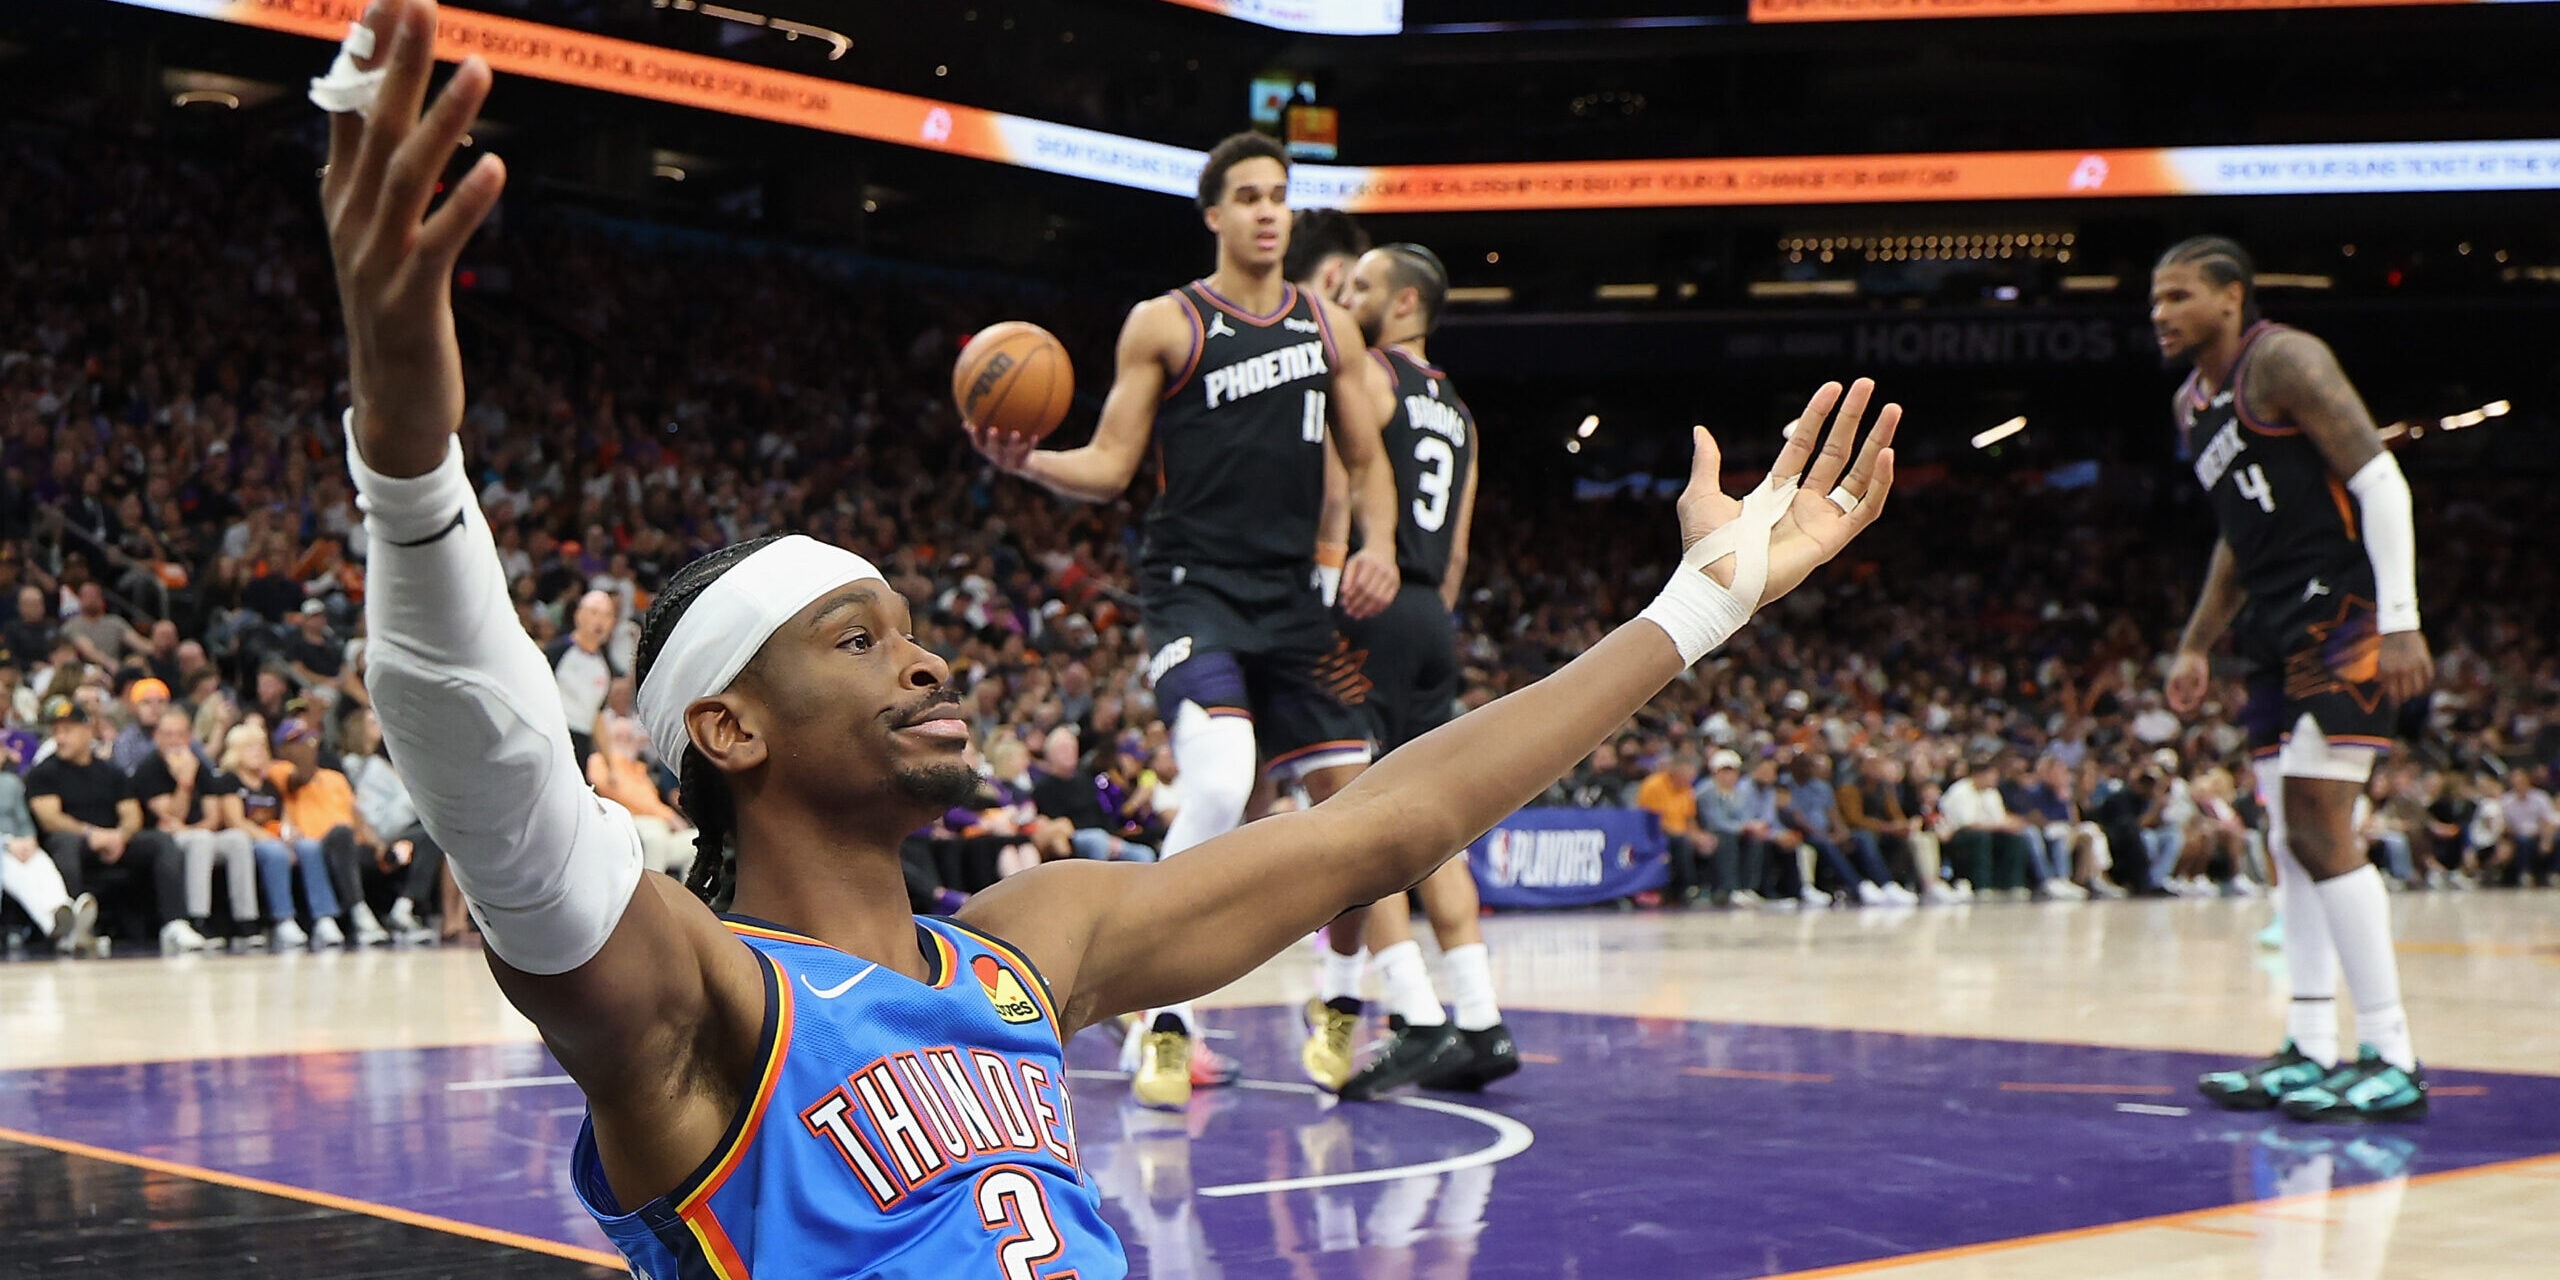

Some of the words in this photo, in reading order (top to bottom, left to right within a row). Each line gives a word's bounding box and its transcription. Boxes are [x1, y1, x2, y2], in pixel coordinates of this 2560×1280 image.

[1853, 321, 2117, 363] HORNITOS
[1203, 339, 1329, 410] PHOENIX
[1302, 389, 1327, 443] 11
[1412, 435, 1455, 533] 3
[2232, 463, 2276, 513] 4
[1511, 829, 1605, 888] PLAYOFFS
[974, 1163, 1080, 1280] 2
